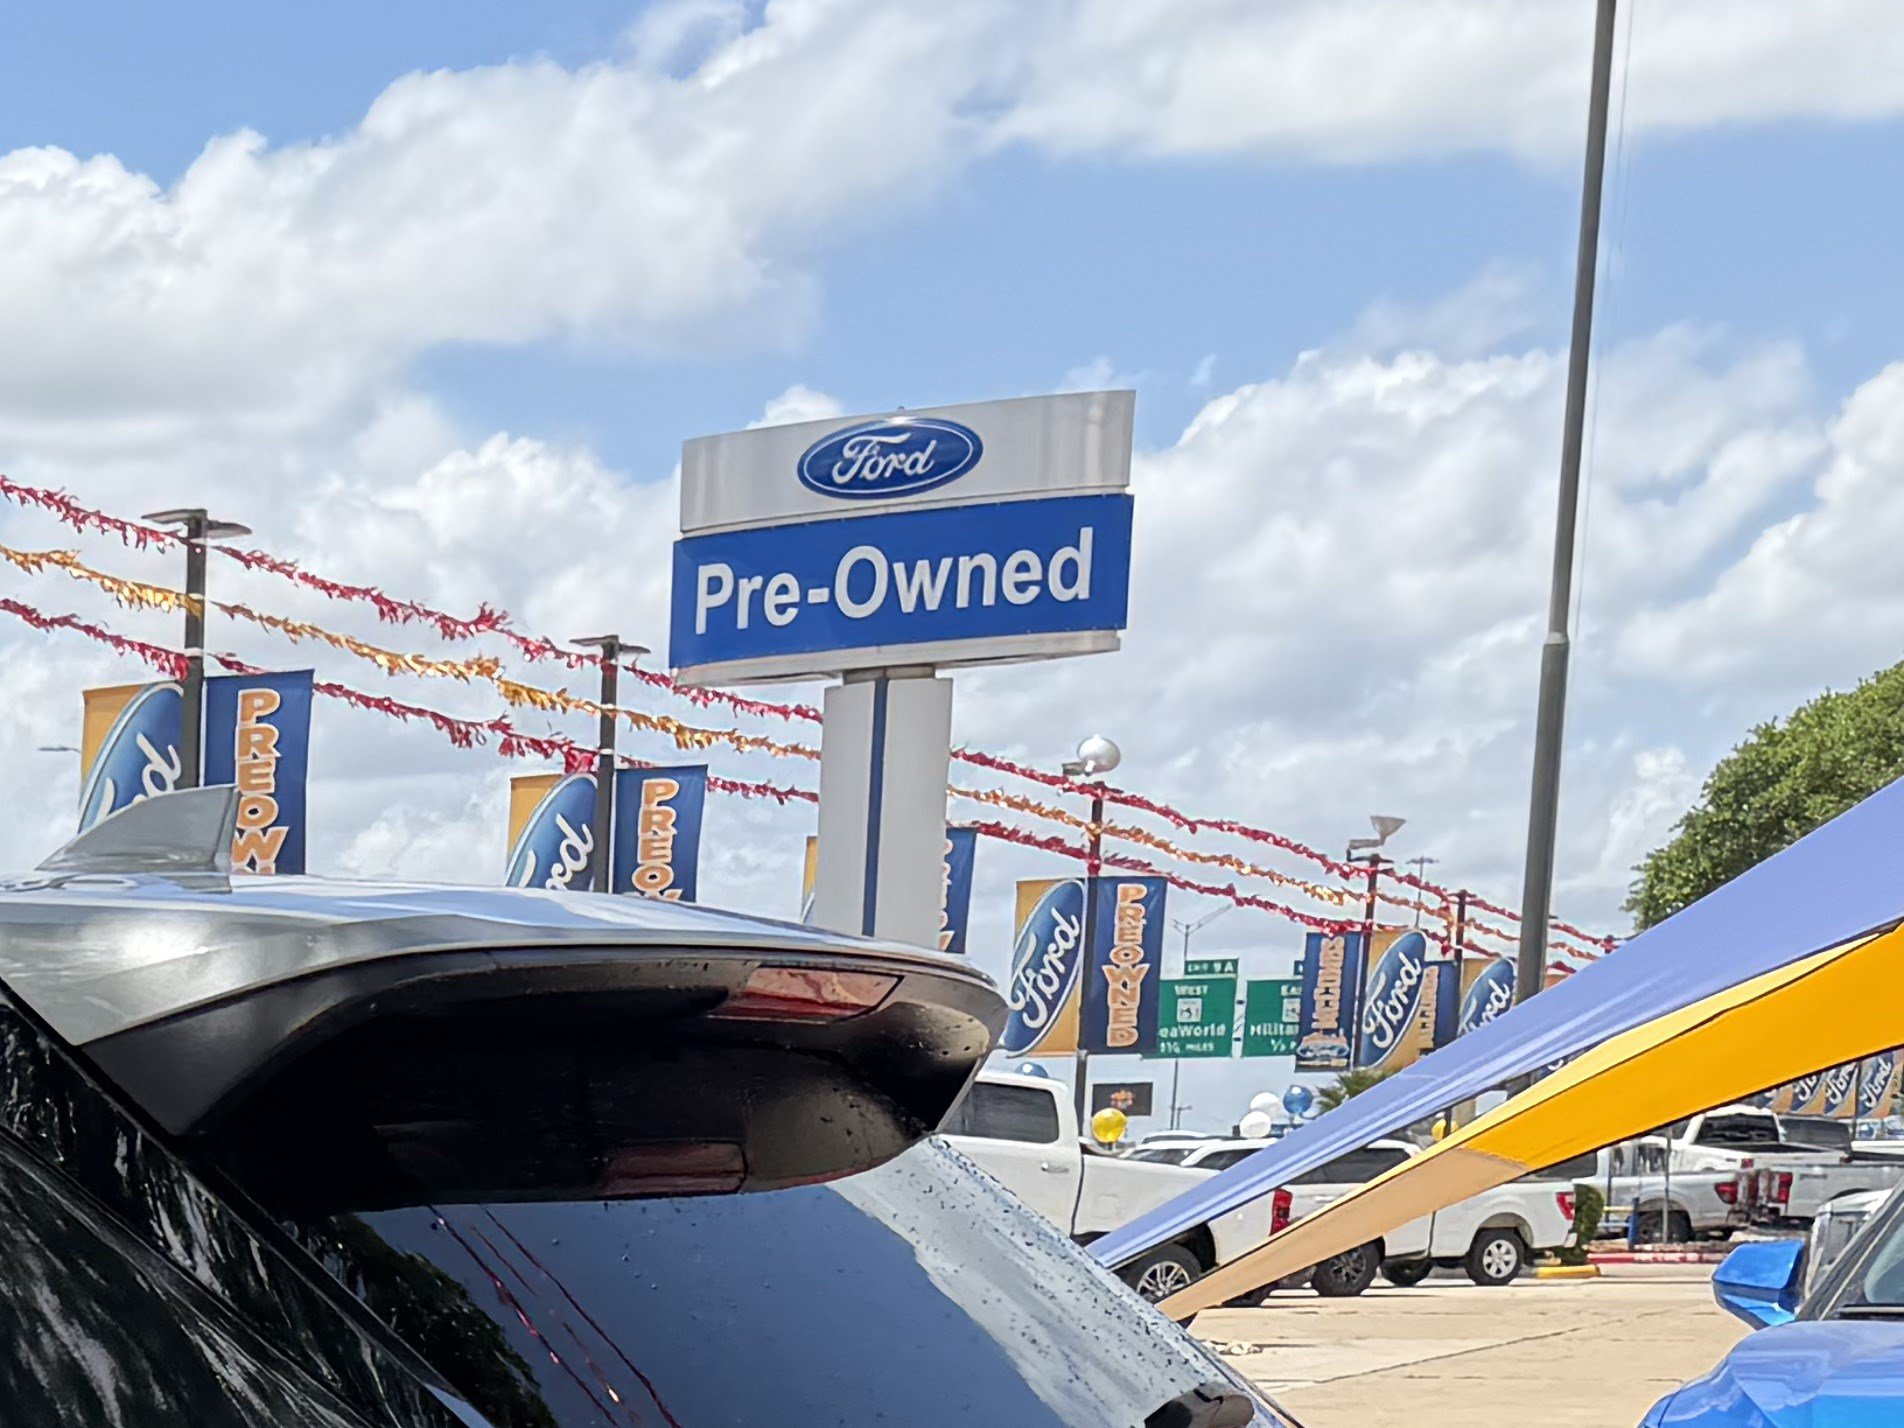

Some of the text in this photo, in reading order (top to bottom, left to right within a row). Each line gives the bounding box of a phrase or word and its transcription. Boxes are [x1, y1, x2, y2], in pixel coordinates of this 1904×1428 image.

[830, 430, 936, 485] Ford
[694, 526, 1094, 635] Pre-Owned
[1007, 907, 1080, 1029] Ford
[1362, 951, 1422, 1049] Ford
